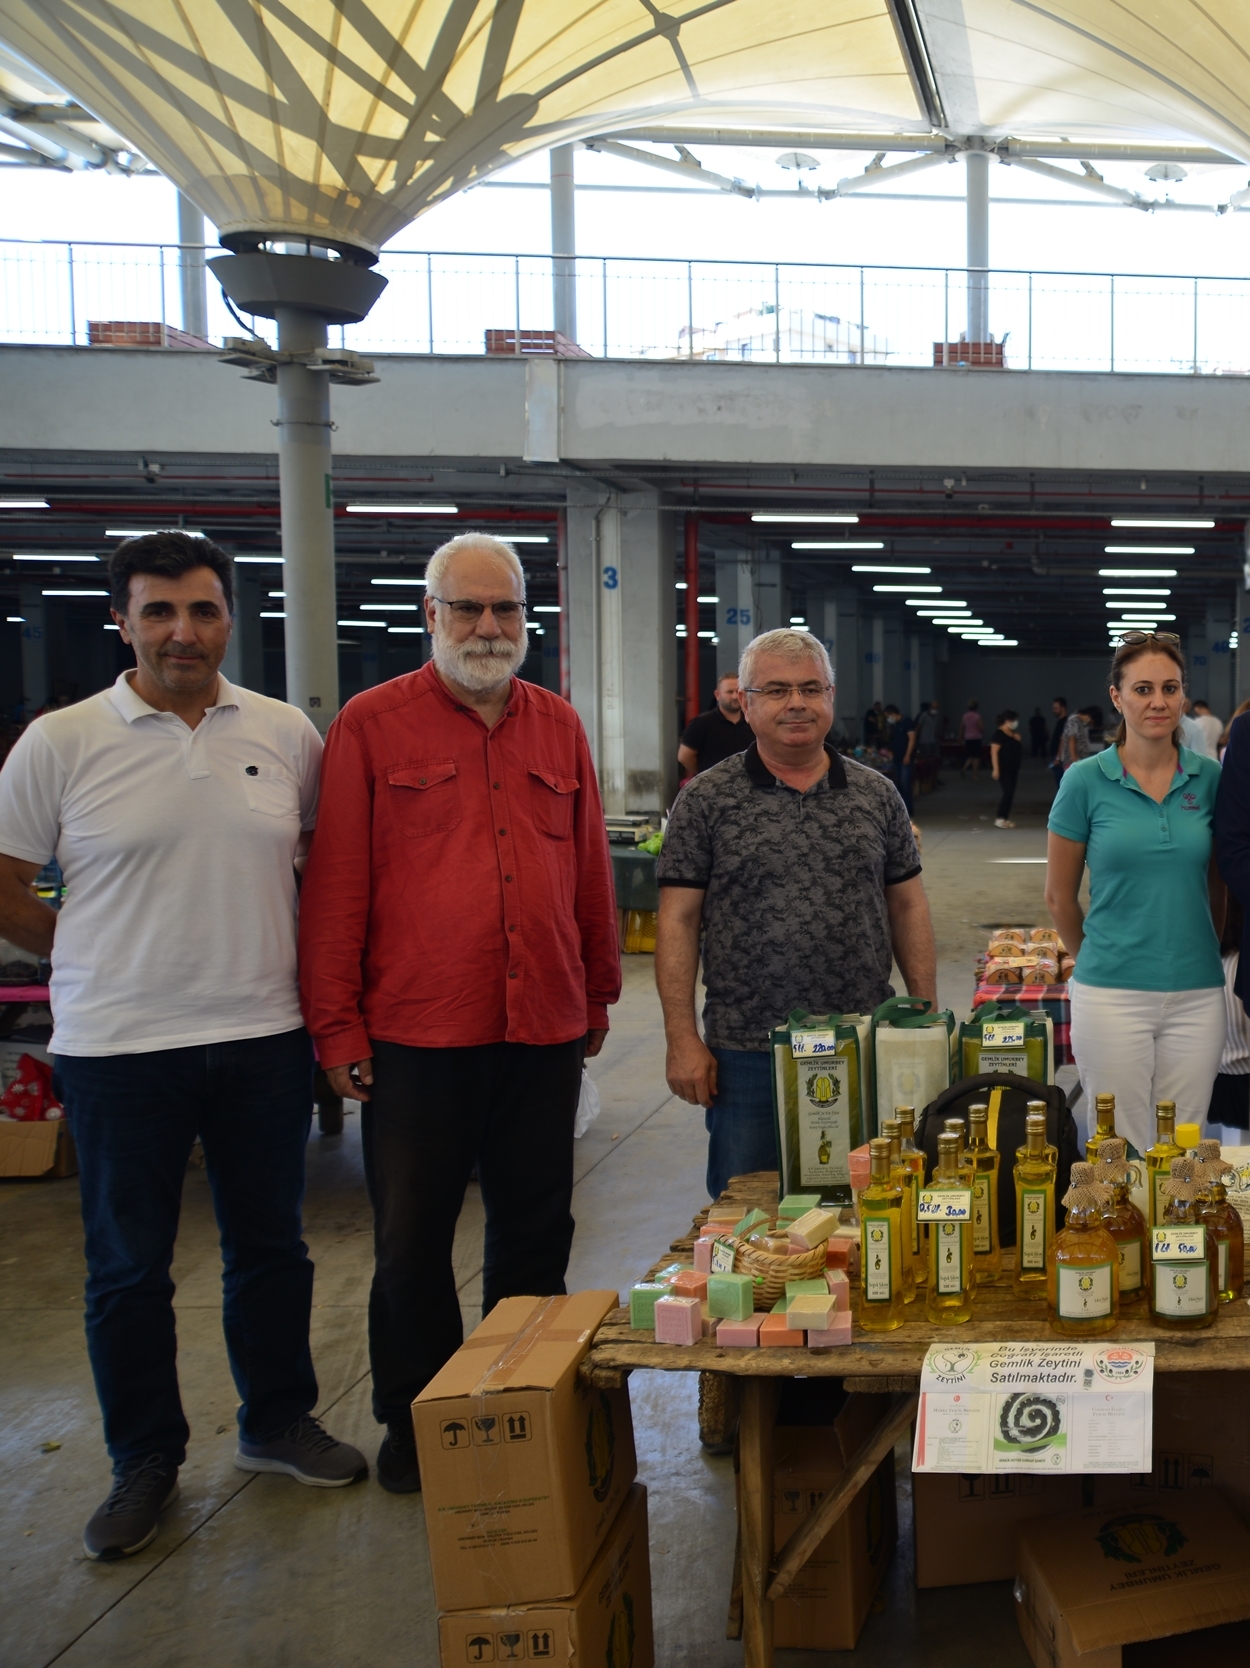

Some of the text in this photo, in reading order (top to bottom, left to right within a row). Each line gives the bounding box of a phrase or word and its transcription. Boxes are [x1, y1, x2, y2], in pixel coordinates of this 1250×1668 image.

[602, 566, 618, 589] 3
[726, 608, 751, 625] 25
[989, 1358, 1082, 1370] Gemlik Zeytini
[936, 1373, 967, 1384] ZEYTİNİ
[990, 1372, 1077, 1384] Satılmaktadır.
[1109, 1563, 1222, 1591] GEMLİK UMURBEY
[1124, 1559, 1197, 1579] ZEYTİNLERİ
